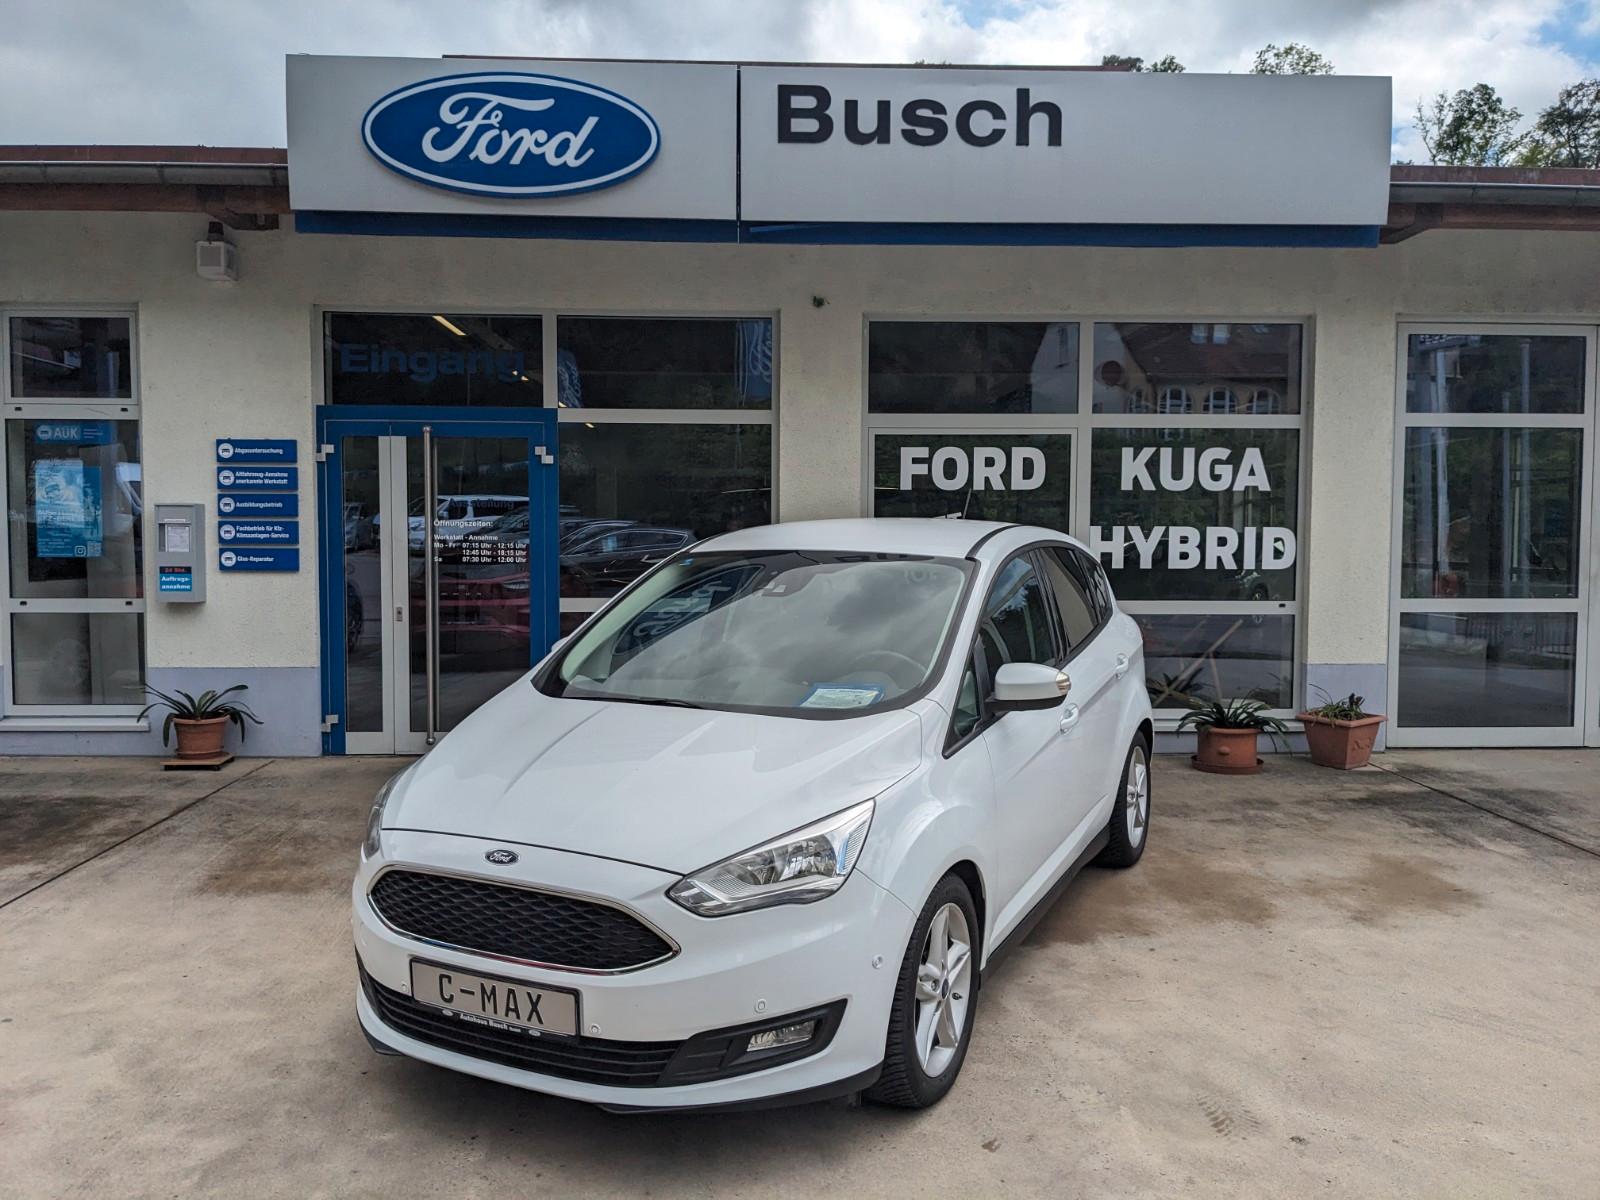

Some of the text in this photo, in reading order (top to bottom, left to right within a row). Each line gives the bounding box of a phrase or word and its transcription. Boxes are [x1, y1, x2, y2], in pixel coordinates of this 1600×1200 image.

[421, 91, 600, 168] Ford
[777, 84, 1063, 147] Busch
[340, 343, 525, 382] Eingang
[54, 427, 78, 439] AUK
[899, 446, 1047, 491] FORD
[1119, 446, 1272, 492] KUGA
[1089, 525, 1297, 570] HYBRID
[490, 850, 513, 863] Ford
[438, 973, 544, 1025] C-MAX
